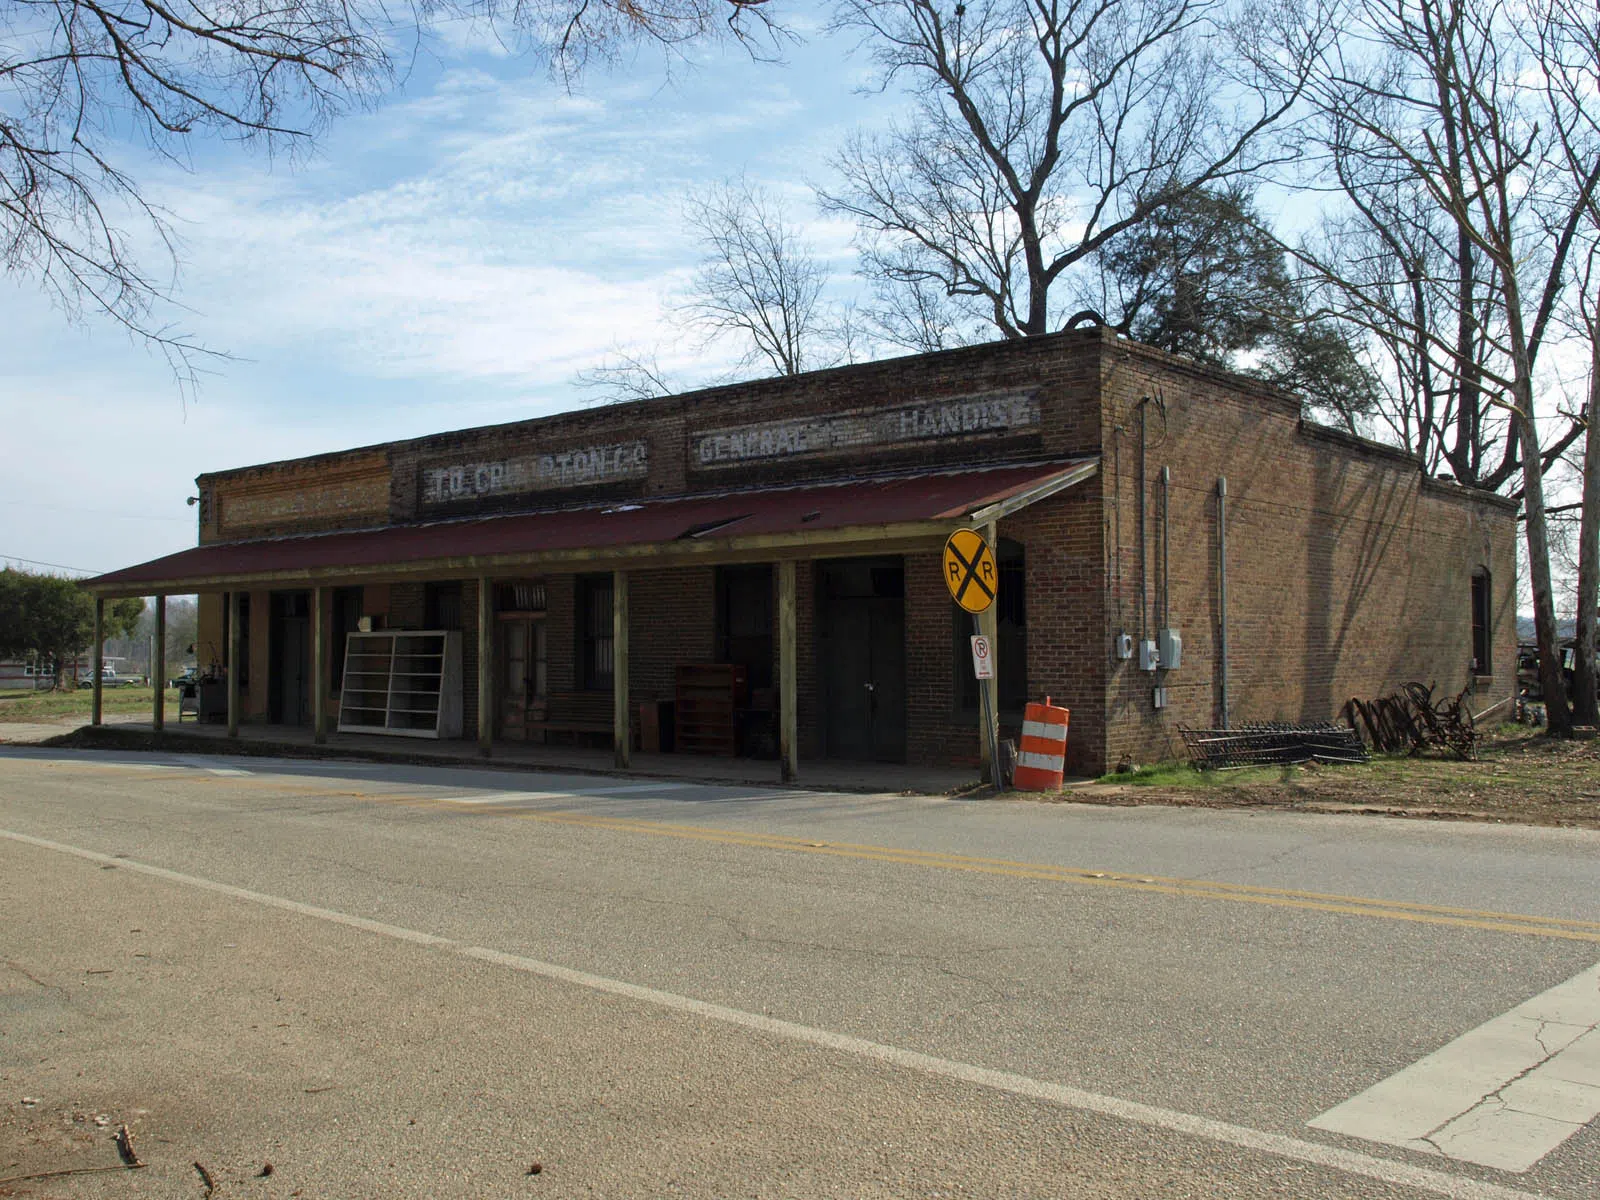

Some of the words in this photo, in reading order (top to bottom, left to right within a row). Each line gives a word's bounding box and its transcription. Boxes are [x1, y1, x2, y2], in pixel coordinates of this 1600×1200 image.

[699, 427, 807, 462] GENERAL
[949, 562, 960, 581] R
[982, 561, 993, 580] R
